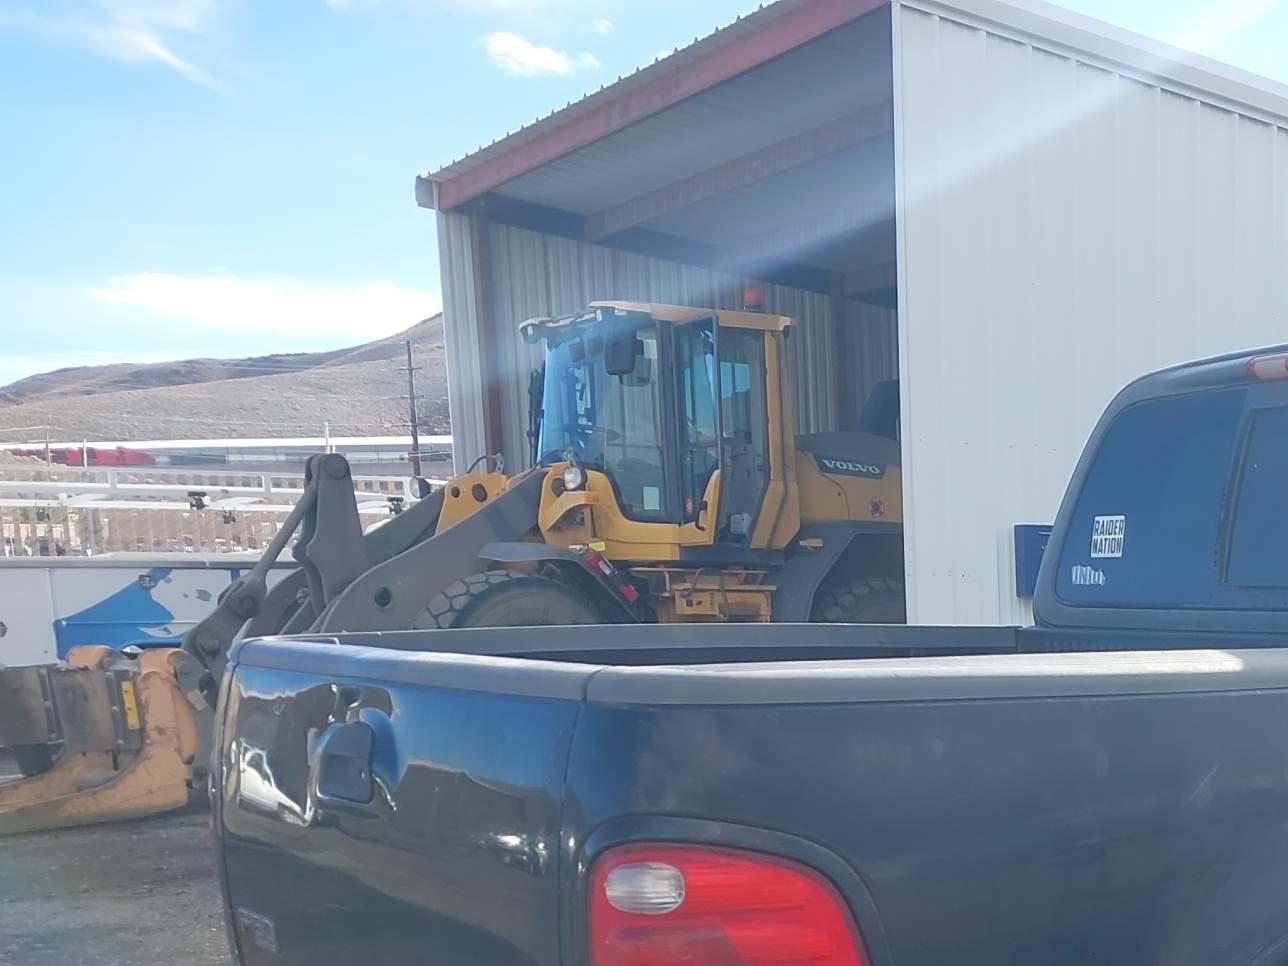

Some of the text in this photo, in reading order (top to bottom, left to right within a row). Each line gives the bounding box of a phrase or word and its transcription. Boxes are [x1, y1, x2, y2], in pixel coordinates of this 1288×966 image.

[821, 459, 881, 474] VOLVO
[1093, 519, 1125, 537] RAIDER
[1092, 537, 1123, 555] NATION
